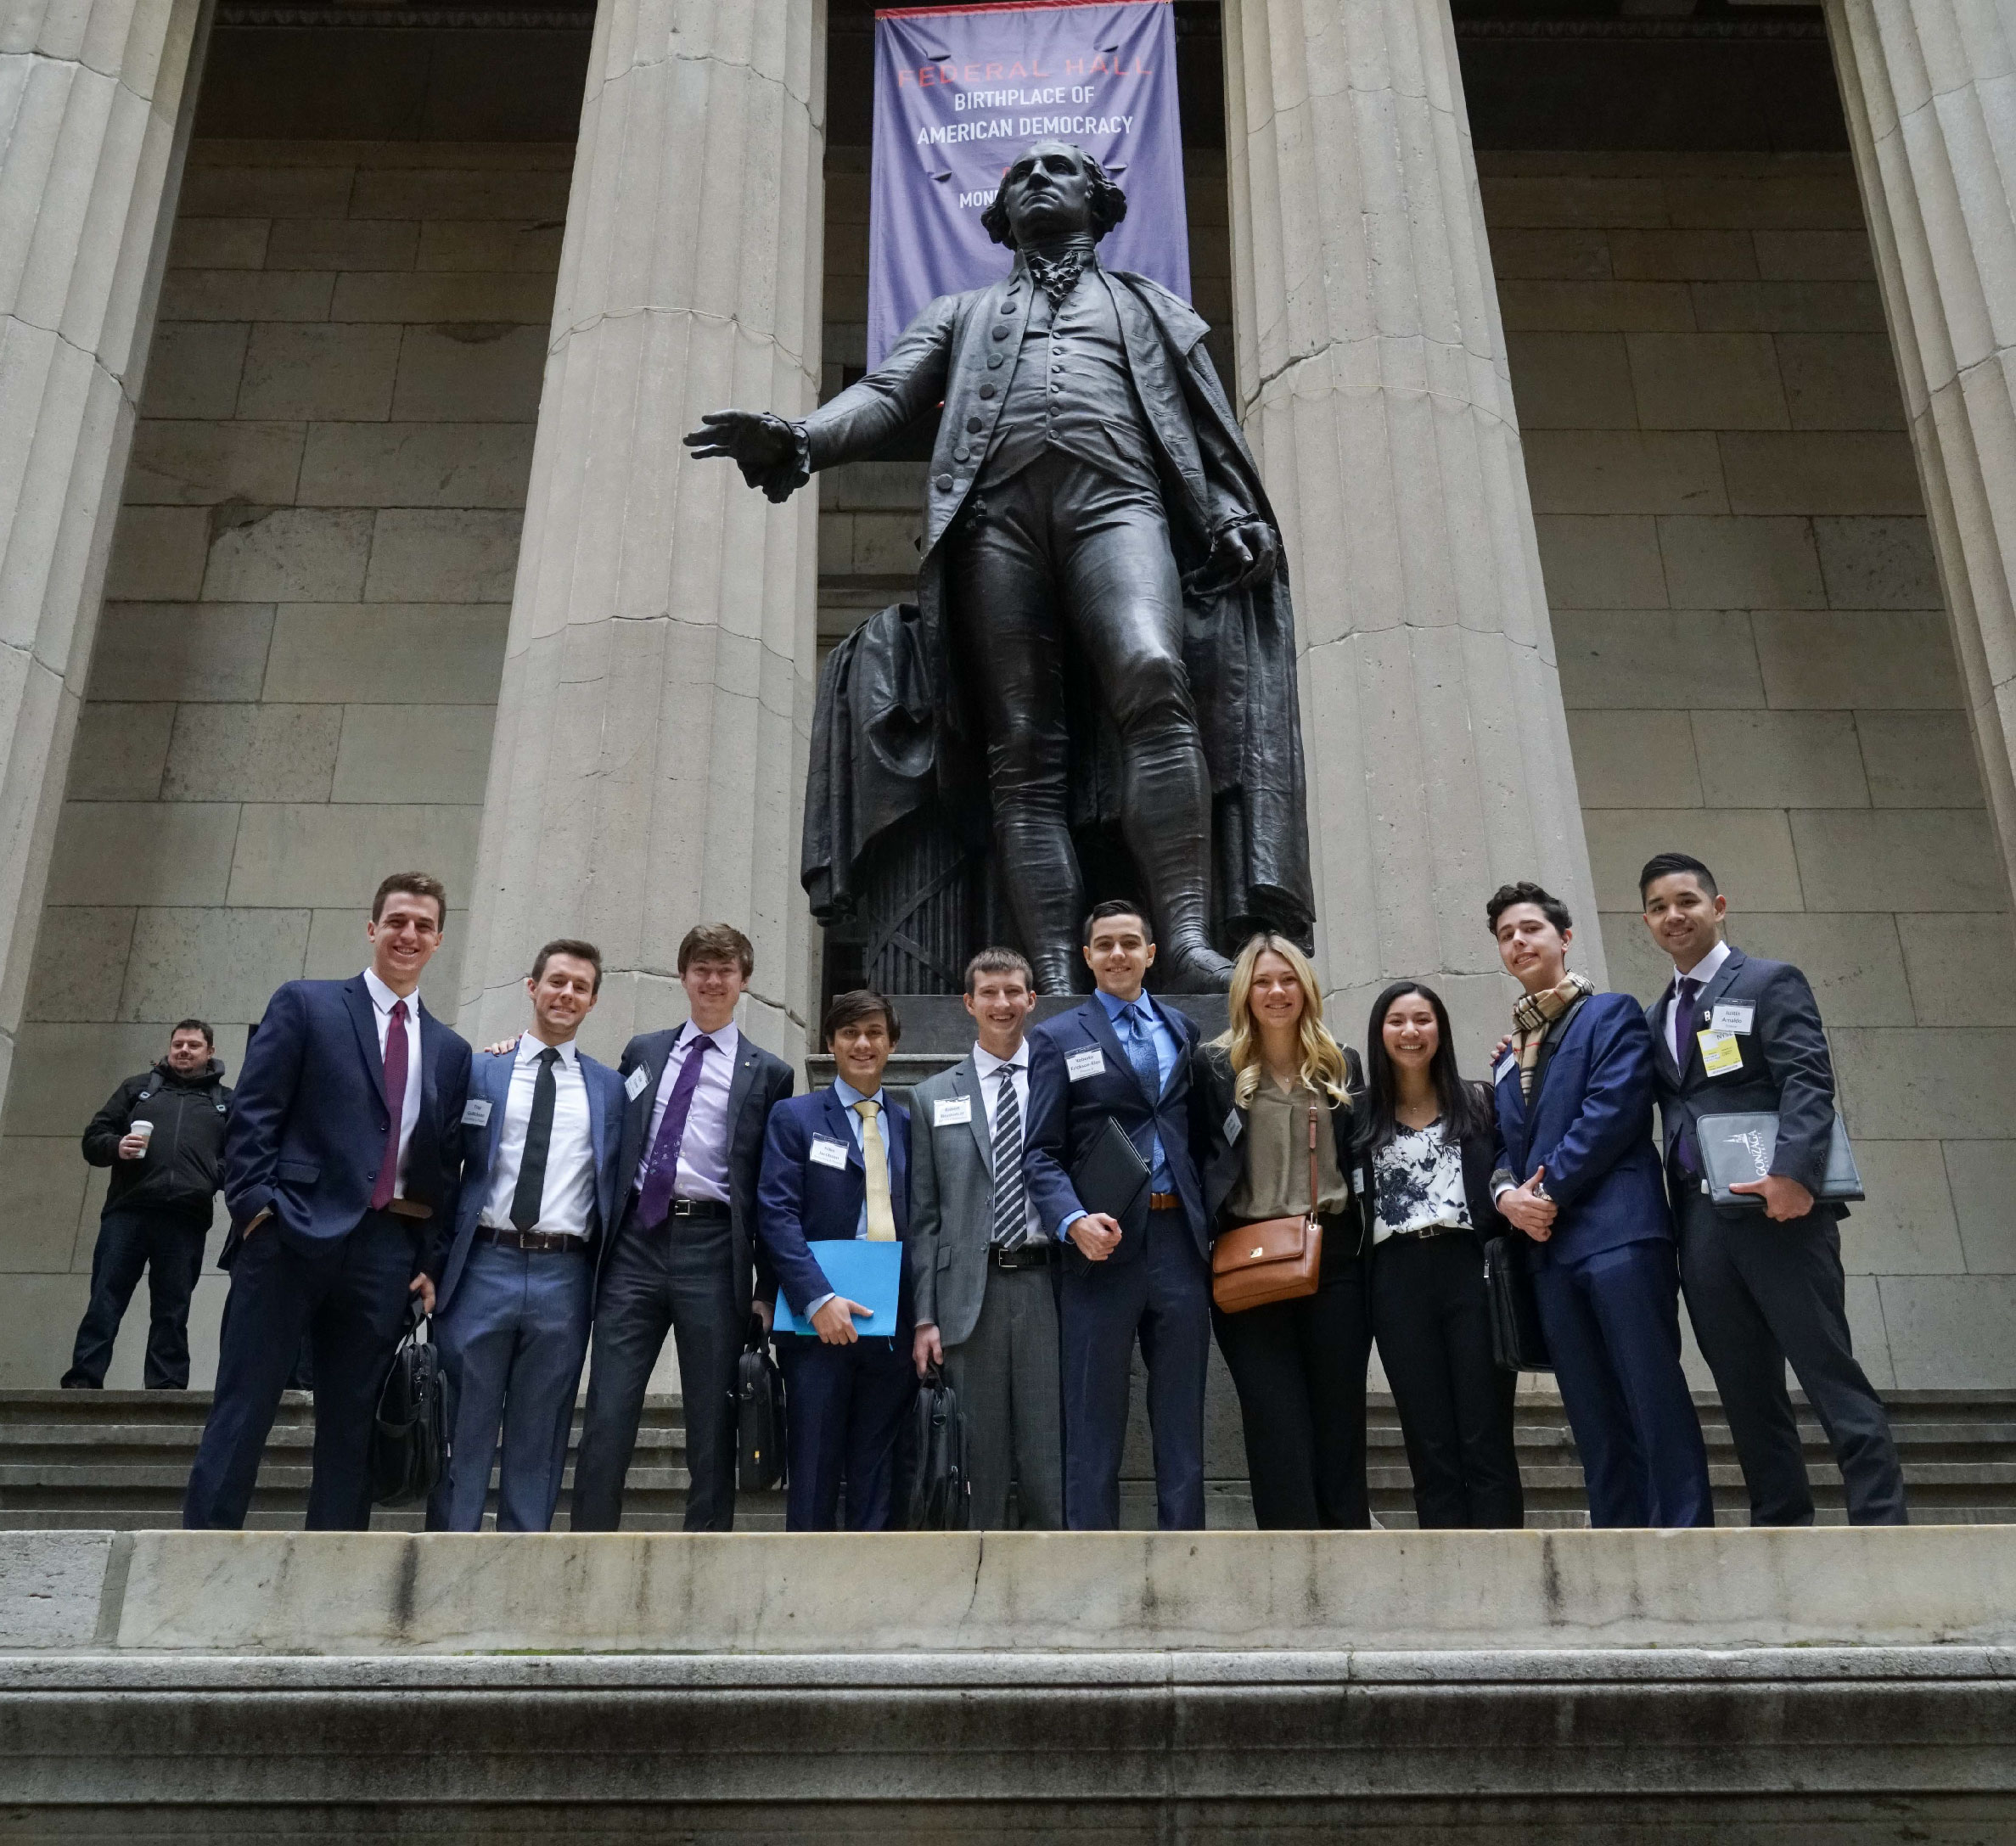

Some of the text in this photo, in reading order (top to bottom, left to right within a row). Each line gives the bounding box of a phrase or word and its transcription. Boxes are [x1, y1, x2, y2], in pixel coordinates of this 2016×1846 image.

[898, 56, 1153, 87] FEDERAL HALL
[955, 86, 1095, 111] BIRTHPLACE OF
[917, 115, 1133, 145] AMERICAN DEMOCRACY
[1748, 1130, 1766, 1175] GONZAGA
